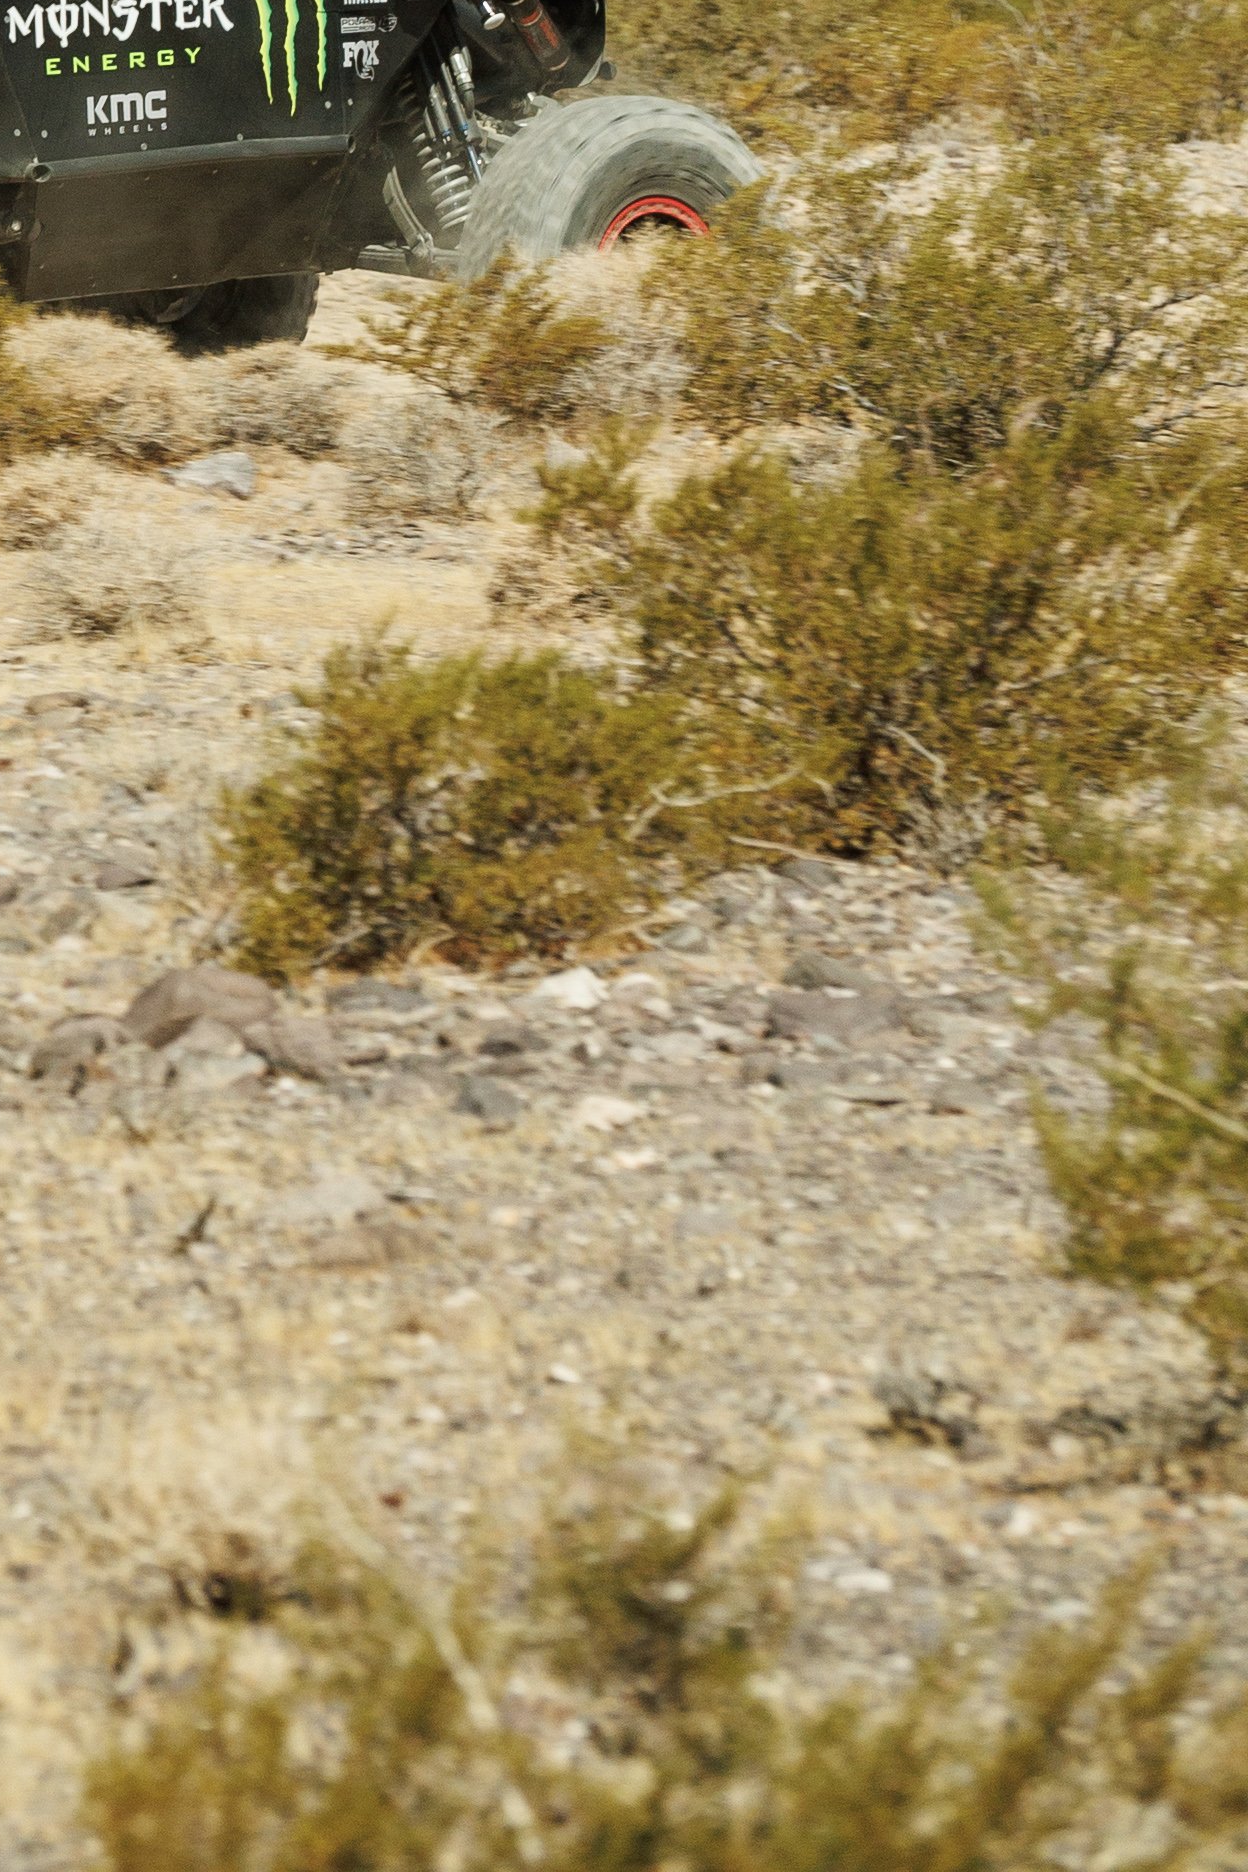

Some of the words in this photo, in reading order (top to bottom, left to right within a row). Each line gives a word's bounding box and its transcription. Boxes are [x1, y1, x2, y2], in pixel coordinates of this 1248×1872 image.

[46, 47, 201, 75] ENERGY
[342, 40, 380, 74] FOX
[86, 90, 167, 125] KMC
[87, 122, 167, 137] WHEELS
